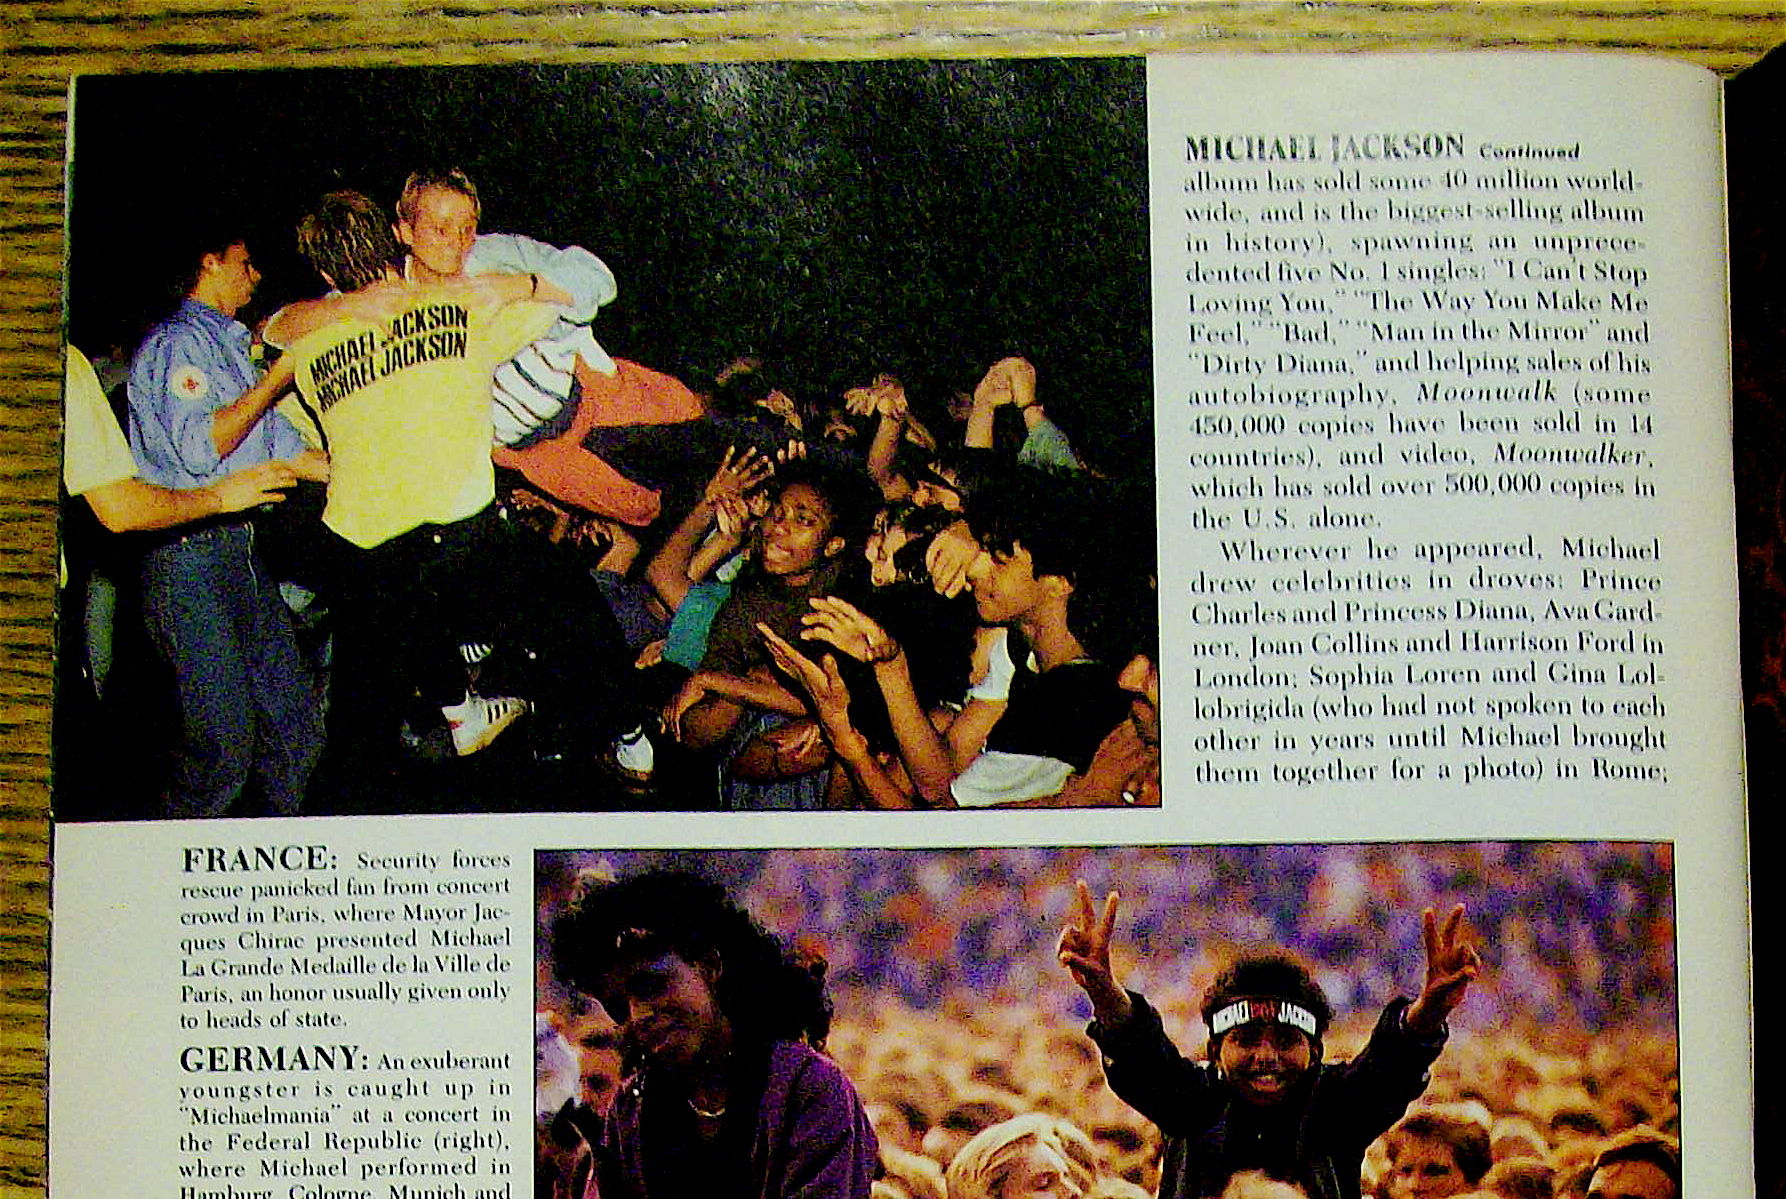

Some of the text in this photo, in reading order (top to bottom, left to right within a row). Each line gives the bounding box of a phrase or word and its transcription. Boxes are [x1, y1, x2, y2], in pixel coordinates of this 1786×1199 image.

[1186, 132, 1580, 163] MICHAEL JACKSON Continued
[309, 329, 375, 386] MICHAEL
[380, 331, 467, 376] JACKSON
[1191, 471, 1655, 502] which has sold over 500,000 copies in
[1192, 504, 1381, 530] the U.S. alone.
[1219, 533, 1660, 565] Wherever he appeared, Michael
[1190, 564, 1661, 594] drew celebrities in droves: Prince
[1194, 690, 1666, 724] lobrigida (who had not spoken to each
[1194, 721, 1666, 756] other in years until Michael brought
[1196, 754, 1668, 787] them together for a photo) in Rome;
[182, 844, 511, 874] FRANCE: Security forces
[181, 875, 510, 903] rescue panicked fan from concert
[180, 904, 239, 926] crowd
[246, 907, 264, 924] in
[272, 905, 326, 924] Paris,
[333, 902, 396, 923] where
[403, 903, 468, 926] Mayor
[180, 926, 511, 956] ques Chirac presented Michael
[181, 952, 511, 978] La Grande Medaille de la Ville de
[181, 978, 511, 1005] Paris, an honor usually given only
[180, 1008, 347, 1030] to heads of state.
[179, 1044, 510, 1073] GERMANY: An exuberant
[179, 1076, 511, 1104] youngster is caught up in
[352, 1107, 370, 1124] at
[382, 1110, 394, 1124] a
[404, 1105, 479, 1123] concert
[492, 1105, 511, 1123] in
[179, 1128, 509, 1155] the Federal Republic (right),
[178, 1154, 510, 1182] where Michael performed in
